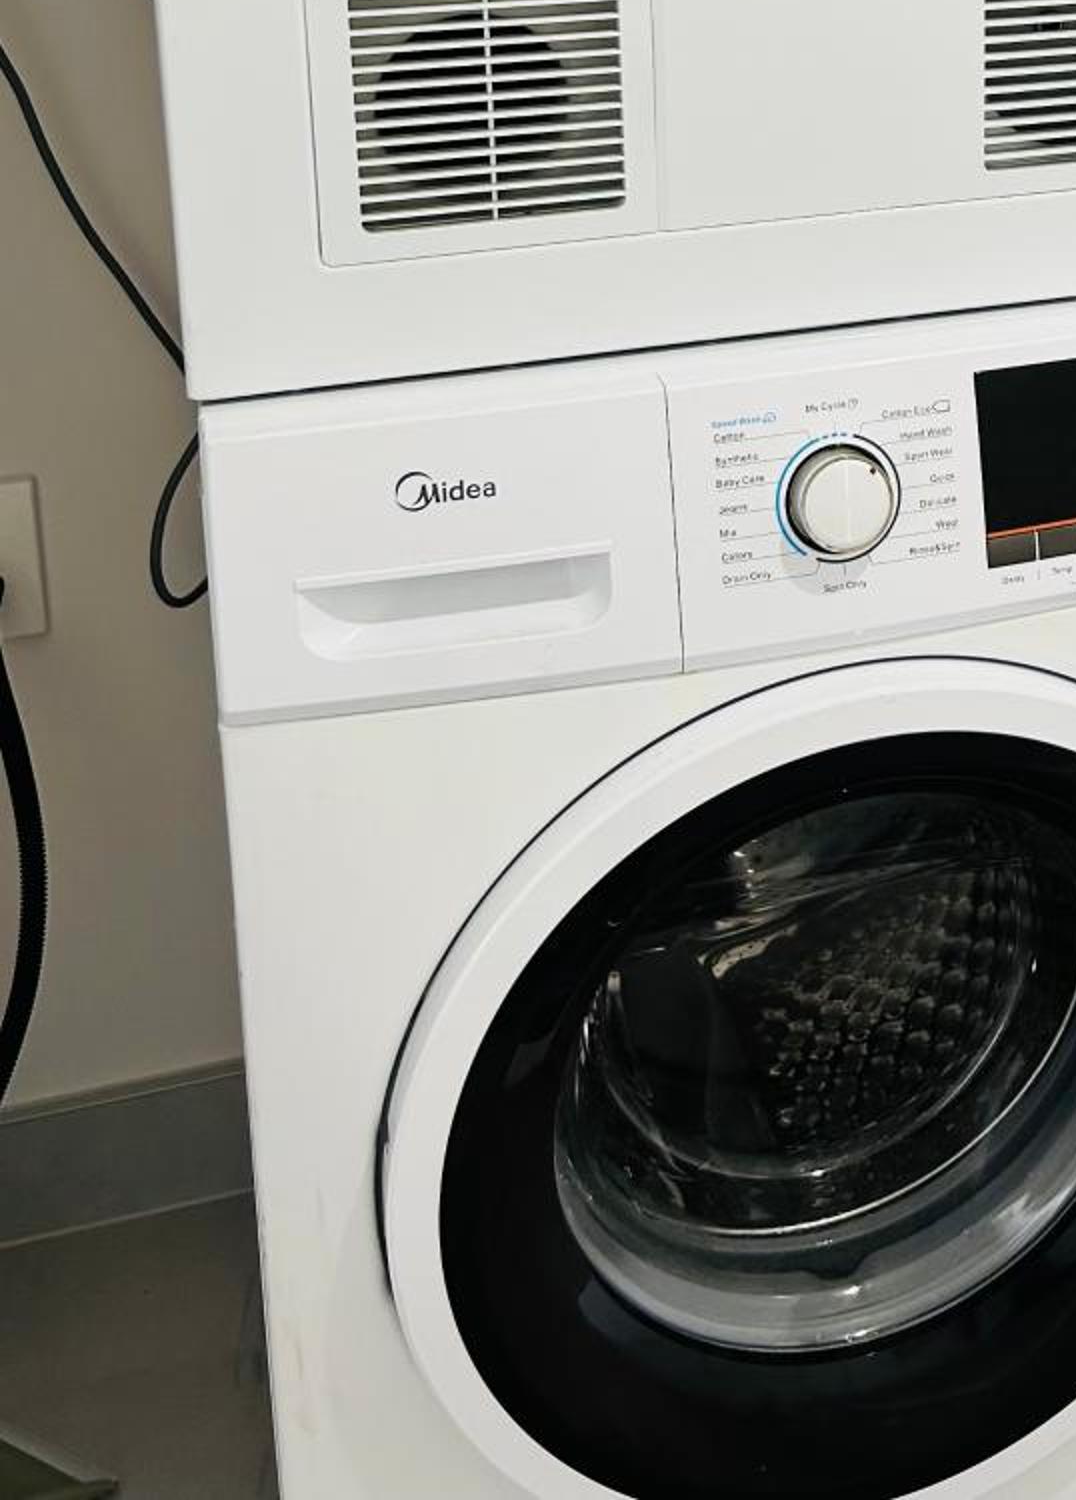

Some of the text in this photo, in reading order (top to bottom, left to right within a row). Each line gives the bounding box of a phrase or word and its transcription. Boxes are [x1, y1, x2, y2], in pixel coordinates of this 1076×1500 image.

[395, 472, 497, 512] Midea
[715, 475, 766, 490] Baby Care
